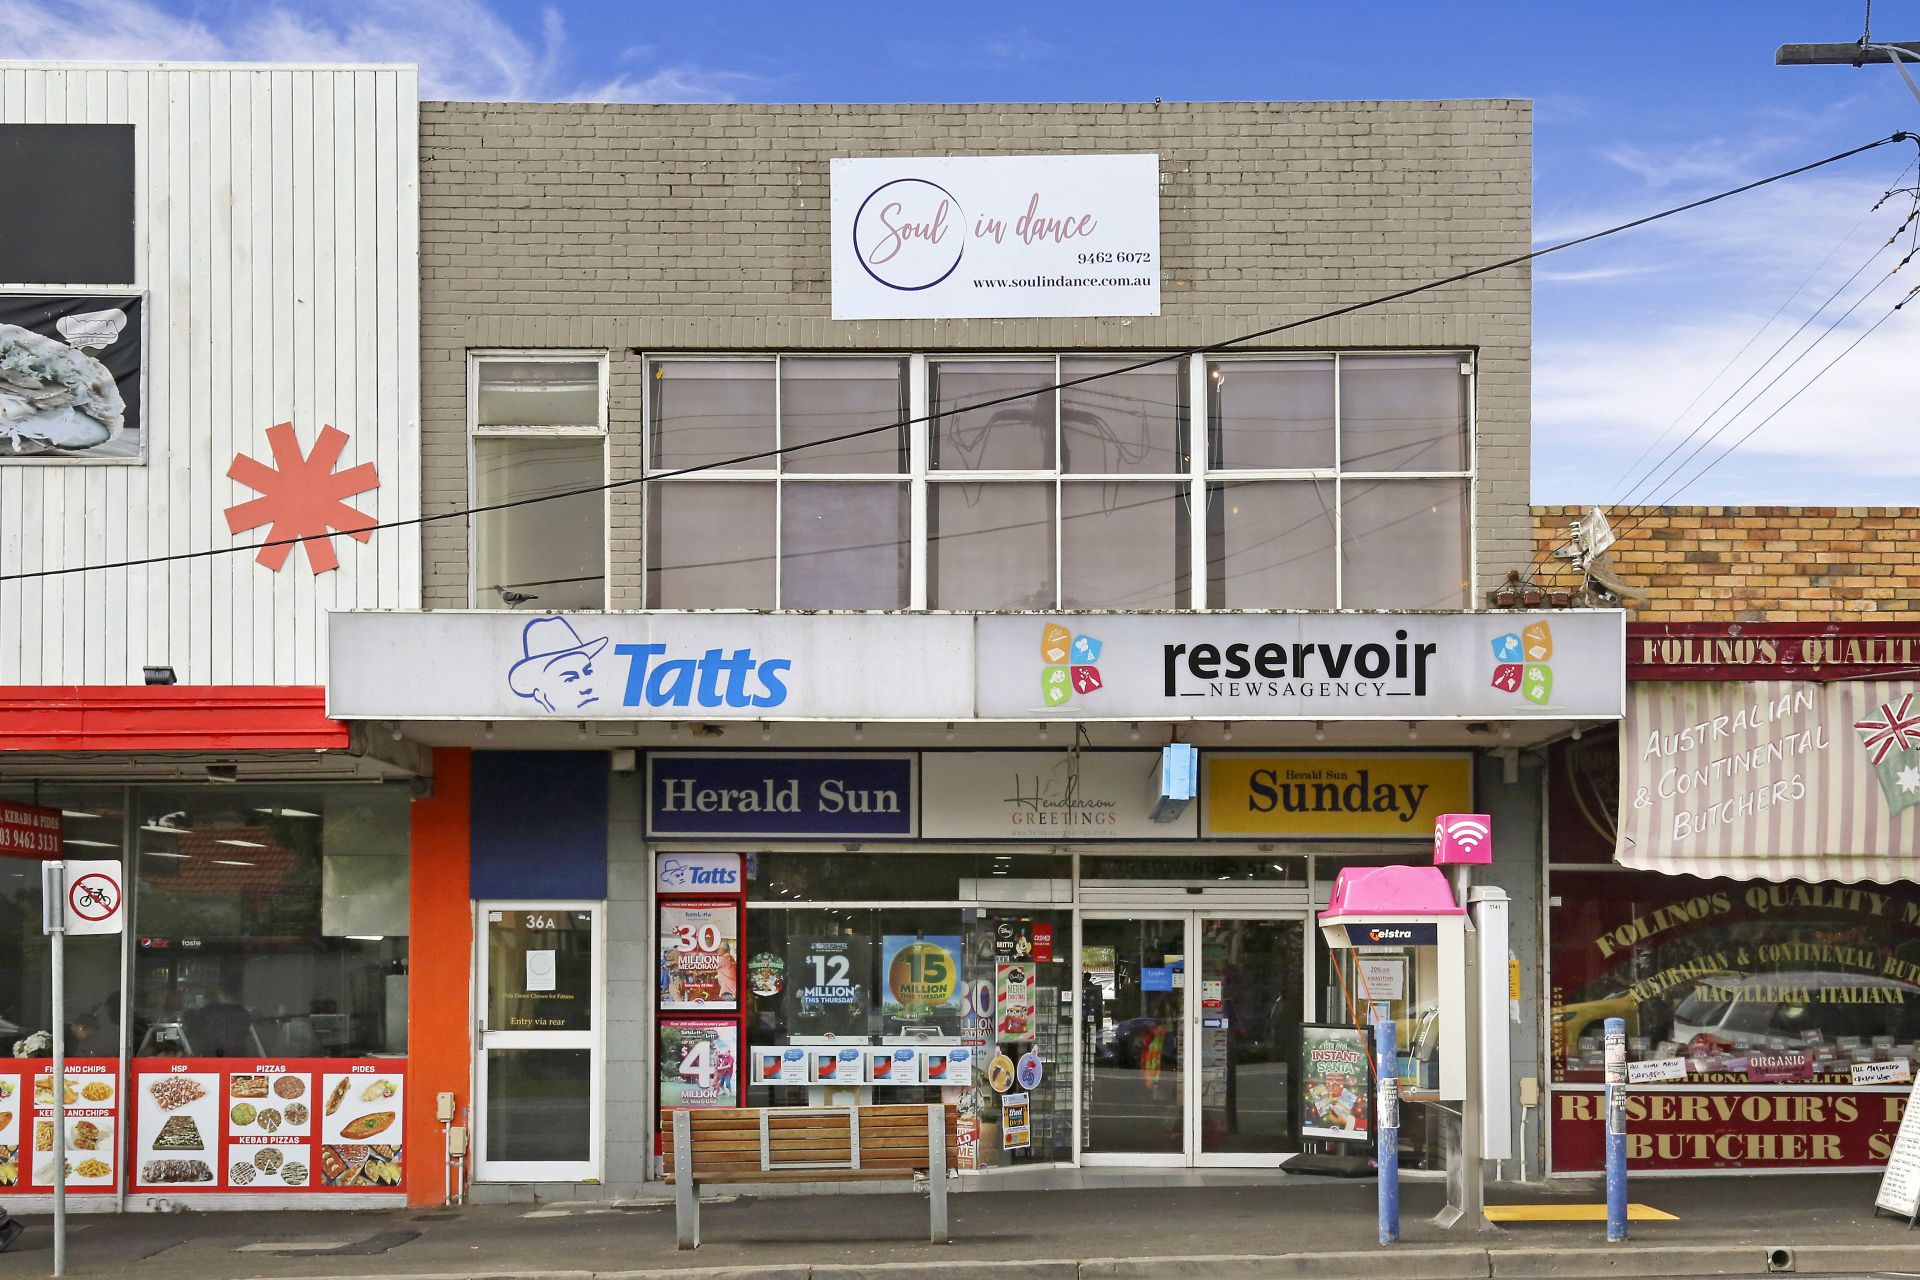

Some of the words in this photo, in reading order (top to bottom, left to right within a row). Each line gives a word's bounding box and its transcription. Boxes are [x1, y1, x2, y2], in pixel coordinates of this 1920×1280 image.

[869, 200, 949, 264] Soul
[974, 213, 1007, 244] in
[1015, 192, 1098, 245] dance
[1077, 251, 1114, 264] 9462
[1116, 251, 1151, 264] 6072
[973, 275, 1151, 288] www.soulindance.com.au
[1164, 629, 1436, 697] reservoir
[1642, 639, 1777, 665] FOLINO'S
[1802, 639, 1920, 671] QUALIT
[613, 643, 792, 708] Tatts
[1209, 682, 1387, 697] NEWSAGENCY
[1643, 689, 1814, 761] AUSTRALIAN
[1286, 769, 1322, 780] Herald
[1326, 769, 1348, 780] Sun
[1634, 787, 1653, 809] &
[1658, 726, 1830, 800] CONTINENTAL
[662, 779, 801, 812] Herald
[818, 779, 900, 813] Sun
[1004, 773, 1116, 813] Henderson
[1249, 768, 1429, 822] Sunday
[1673, 774, 1806, 842] BUTCHERS
[4, 809, 32, 826] KEBABS
[40, 815, 60, 830] PIDES
[1012, 812, 1116, 825] GREETINGS
[13, 829, 35, 849] 9462
[38, 833, 58, 852] 3131
[689, 866, 736, 884] Tatts
[526, 915, 556, 929] 36A
[1595, 892, 1731, 959] FOLINO'S
[1745, 885, 1893, 916] QUALITY
[1369, 929, 1412, 941] Telstra
[678, 955, 720, 964] MILLION
[1628, 952, 1729, 1007] AUSTRALIAN
[1737, 947, 1751, 966] &
[1759, 944, 1876, 971] CONTINENTAL
[804, 987, 855, 997] MILLION
[900, 985, 947, 993] MILLION
[1695, 985, 1811, 1003] MACELLERIA
[1820, 986, 1905, 1004] ITALIANA
[511, 1016, 533, 1027] Entry
[535, 1017, 547, 1025] via
[549, 1017, 566, 1026] rear
[1311, 1050, 1359, 1063] INSTANT
[1750, 1055, 1805, 1067] ORGANIC
[256, 1065, 286, 1073] PIZZAS
[1317, 1062, 1355, 1074] SANTA
[681, 1090, 717, 1098] MILLION
[239, 1136, 268, 1144] KEBAB
[270, 1136, 300, 1144] PIZZAS
[1626, 1133, 1844, 1160] BUTCHER
